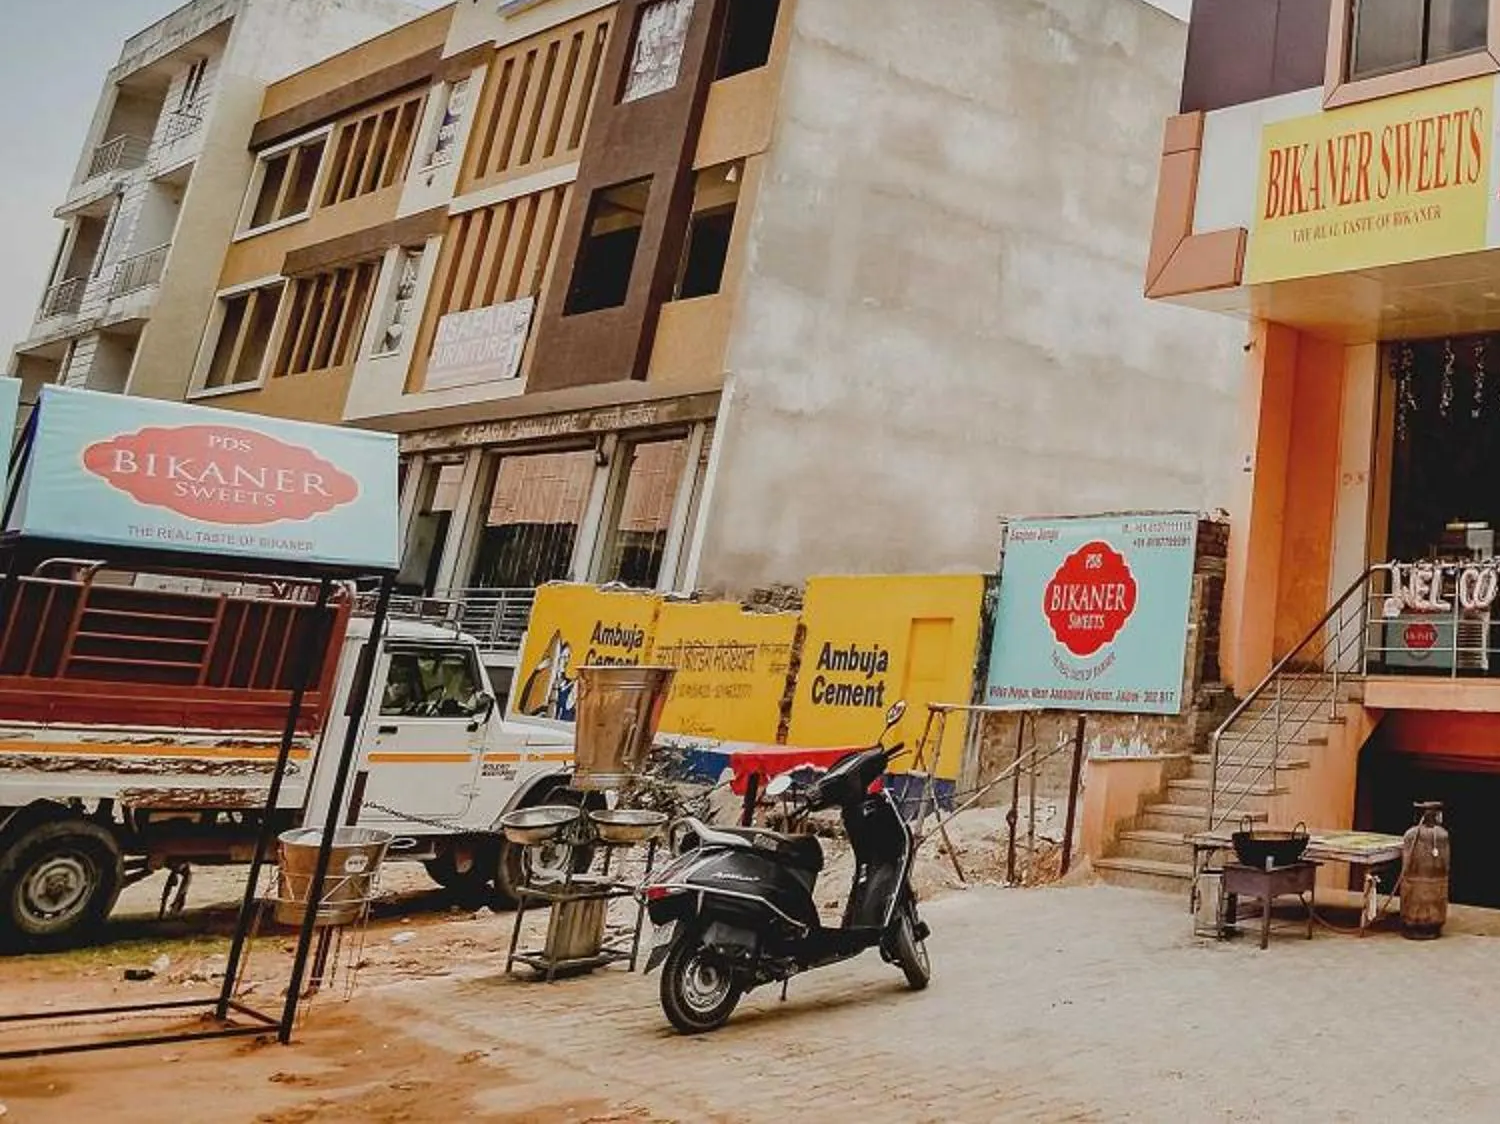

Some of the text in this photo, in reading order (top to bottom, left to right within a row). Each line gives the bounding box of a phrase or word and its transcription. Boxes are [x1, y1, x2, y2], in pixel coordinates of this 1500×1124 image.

[1264, 107, 1484, 220] BIKANER SWEETS
[207, 434, 252, 453] PDS
[112, 448, 333, 497] BIKANER
[174, 481, 277, 507] SWEETS
[127, 524, 153, 538] THE
[157, 527, 192, 542] REAL
[196, 531, 237, 546] TASTE
[1051, 582, 1128, 611] BIKANER
[590, 619, 645, 653] Ambuja
[1067, 611, 1105, 630] SWEETS
[816, 641, 889, 680] Ambuja
[811, 674, 885, 708] Cement
